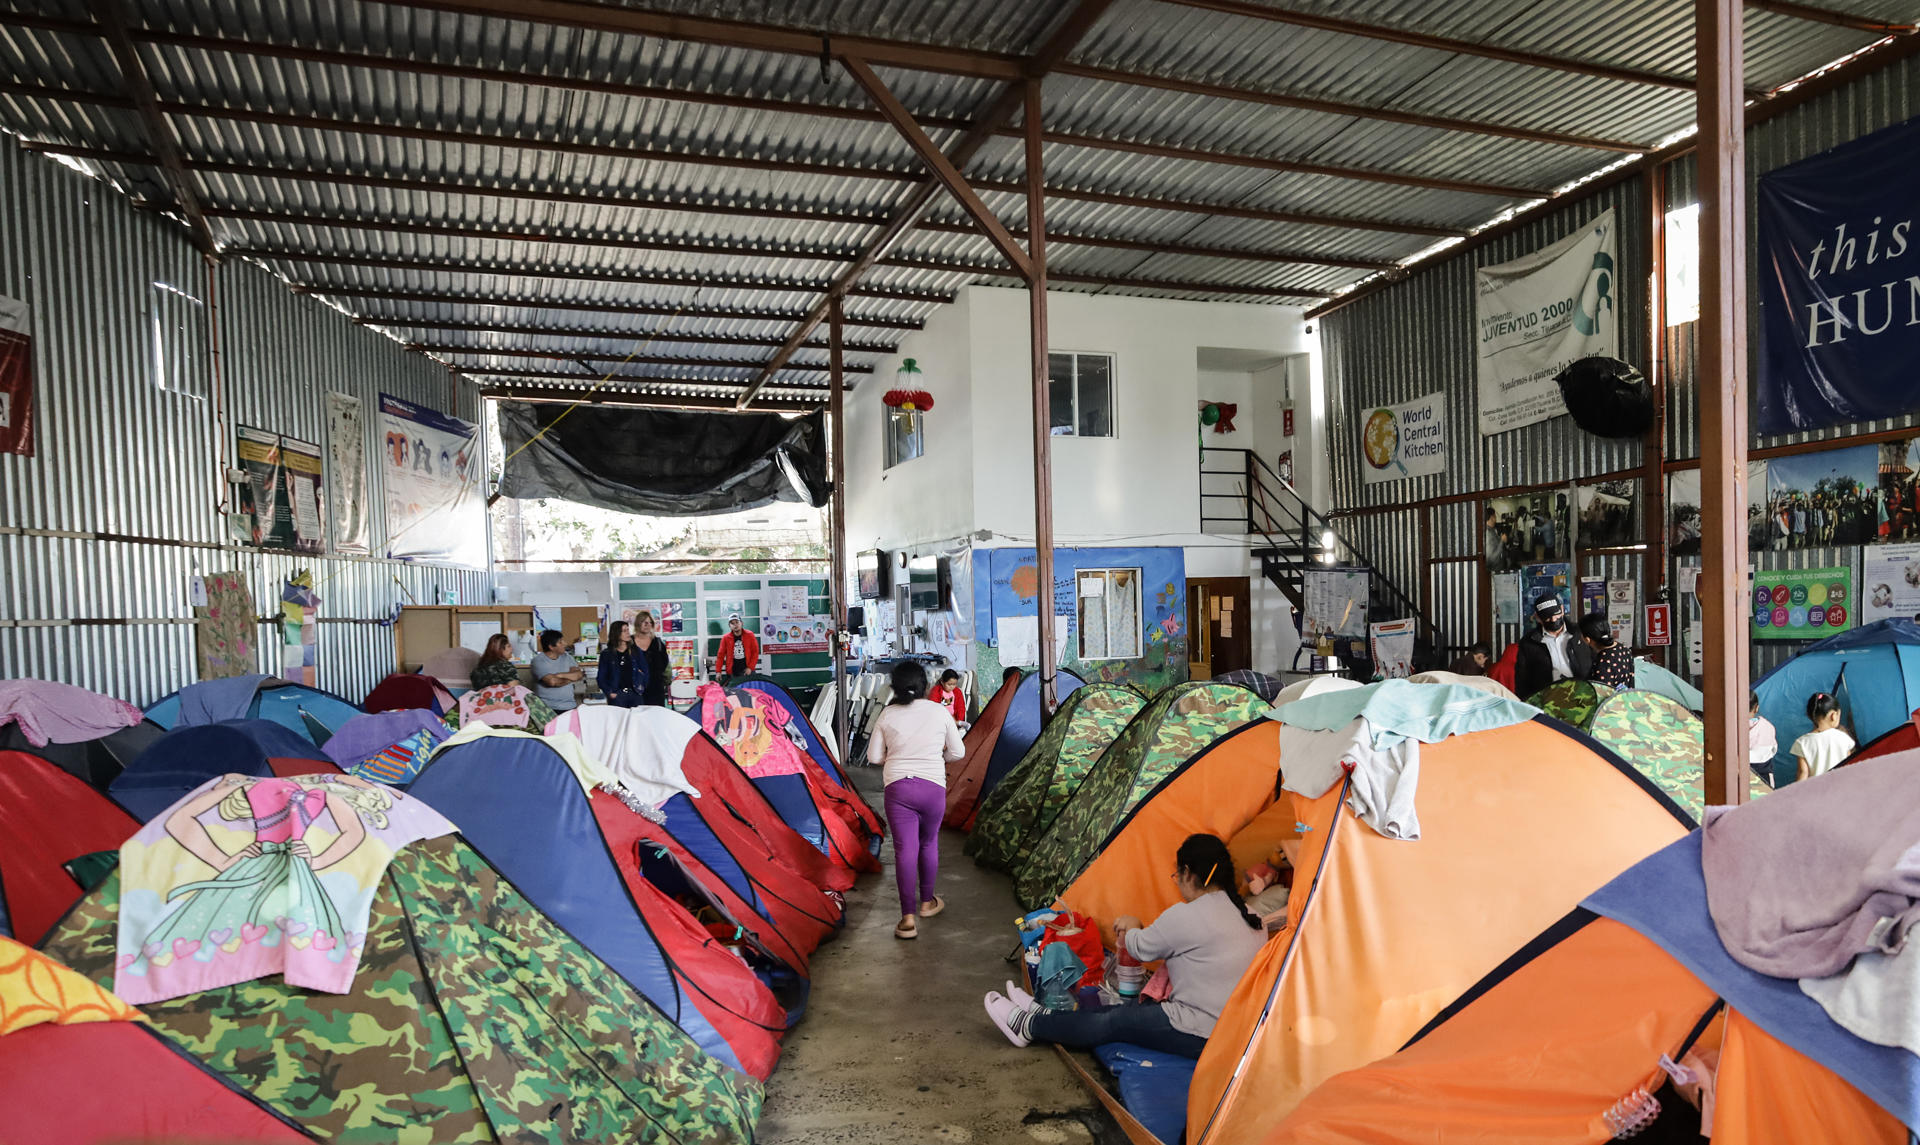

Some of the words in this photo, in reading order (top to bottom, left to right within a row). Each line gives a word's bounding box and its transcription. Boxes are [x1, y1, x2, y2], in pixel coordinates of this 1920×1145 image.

[1808, 216, 1911, 280] this
[1541, 298, 1573, 321] 2000
[1403, 406, 1431, 424] World
[1404, 421, 1440, 441] Central
[1404, 441, 1444, 459] Kitchen
